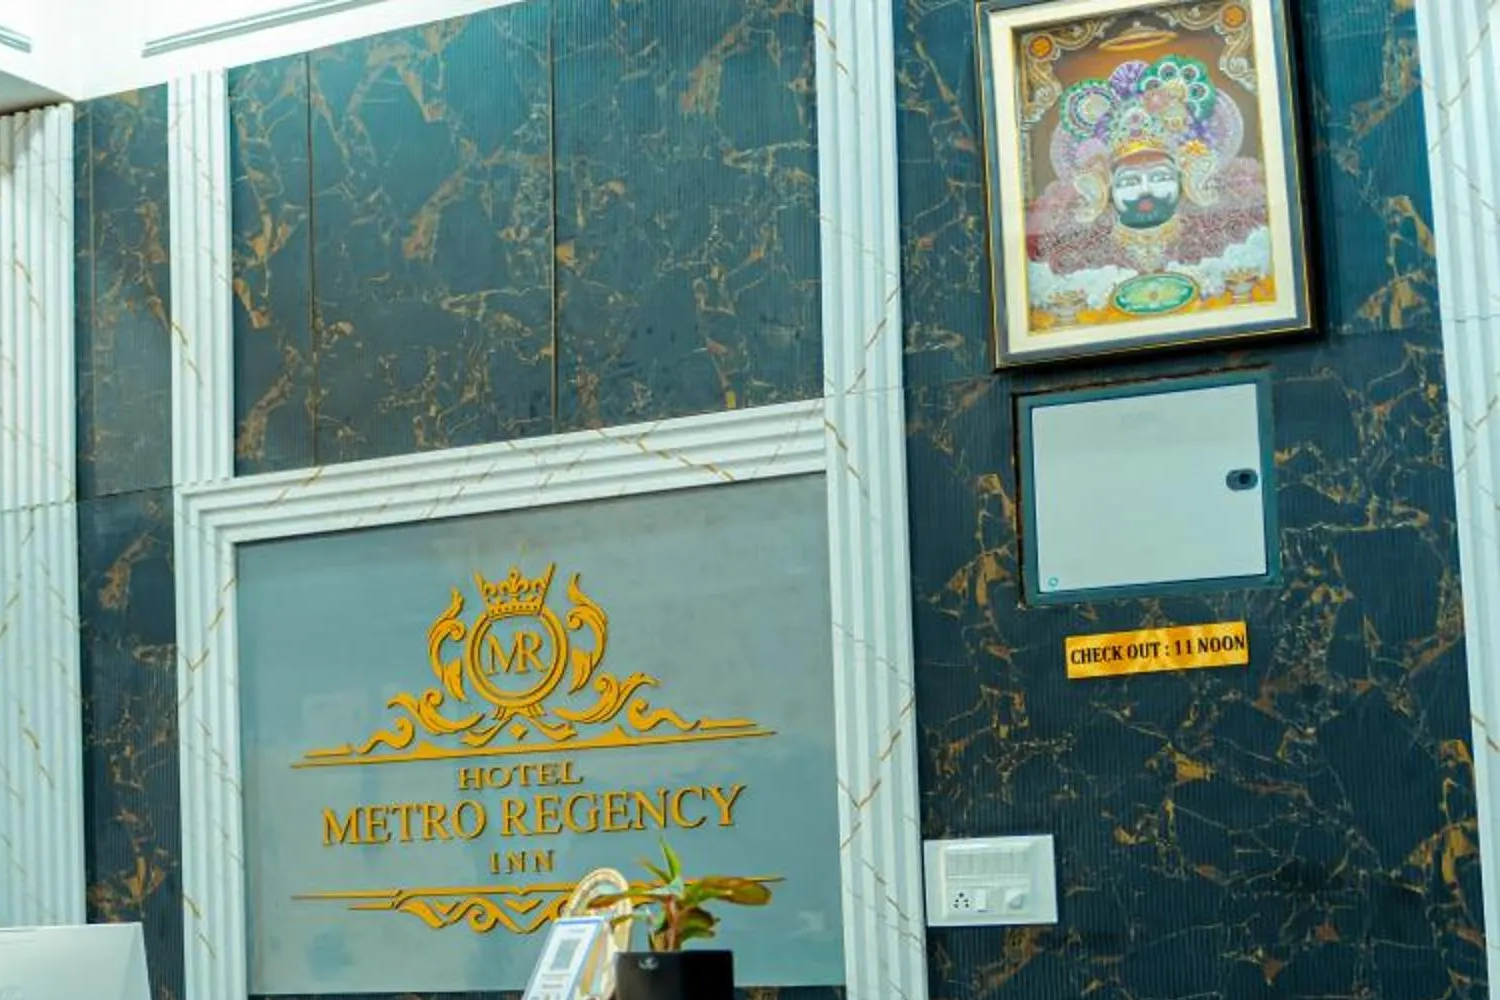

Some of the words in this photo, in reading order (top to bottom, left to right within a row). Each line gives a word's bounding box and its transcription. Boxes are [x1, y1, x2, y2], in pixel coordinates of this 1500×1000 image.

[485, 631, 547, 675] MR
[1070, 645, 1123, 665] CHECK
[1127, 642, 1161, 659] OUT
[1174, 639, 1193, 656] 11
[1197, 634, 1245, 653] NOON
[457, 761, 583, 791] HOTEL
[321, 799, 487, 846] METRO
[500, 784, 747, 837] REGENCY
[490, 849, 555, 874] INN
